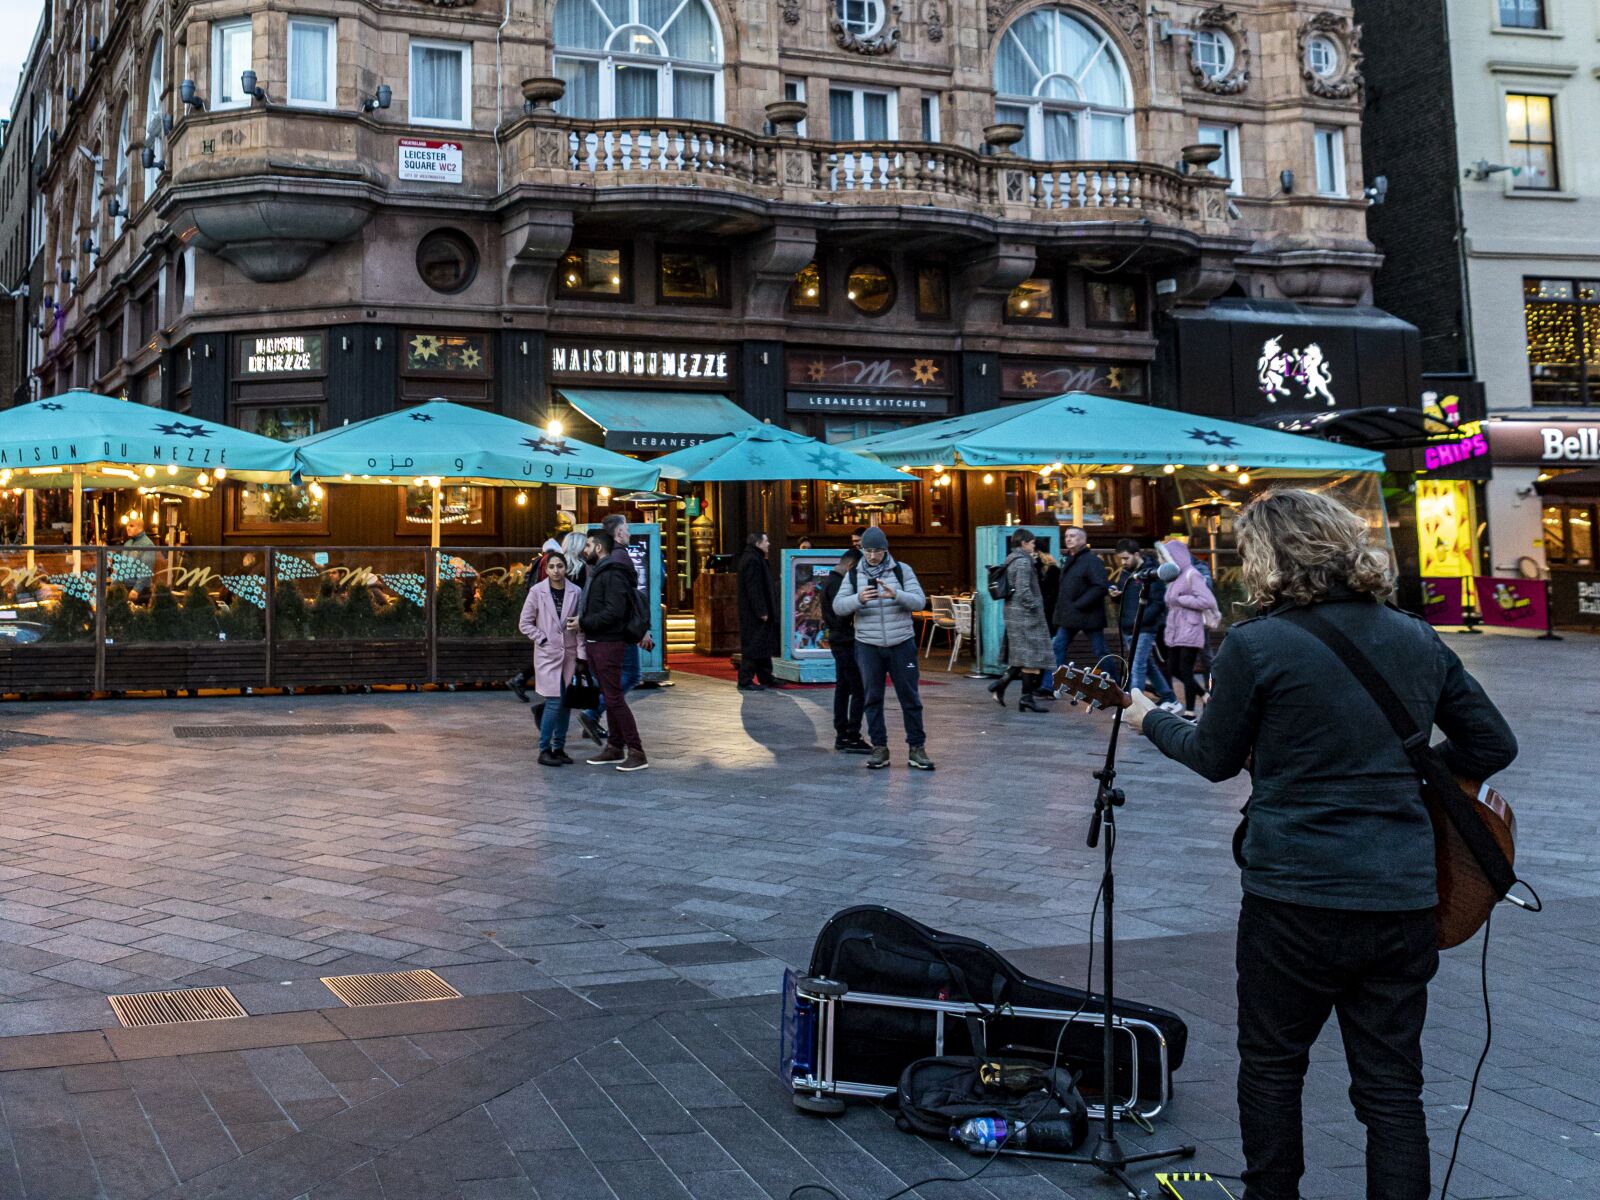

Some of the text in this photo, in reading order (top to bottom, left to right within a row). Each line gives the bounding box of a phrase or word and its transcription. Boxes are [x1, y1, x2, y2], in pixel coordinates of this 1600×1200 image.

[404, 150, 447, 161] LEICESTER
[404, 160, 457, 172] SQUARE WC2
[552, 348, 630, 373] MAISON
[809, 397, 927, 408] LEBANESE KITCHEN
[104, 442, 127, 457] DU
[1424, 433, 1489, 470] CHIPS
[1541, 428, 1600, 461] Bell
